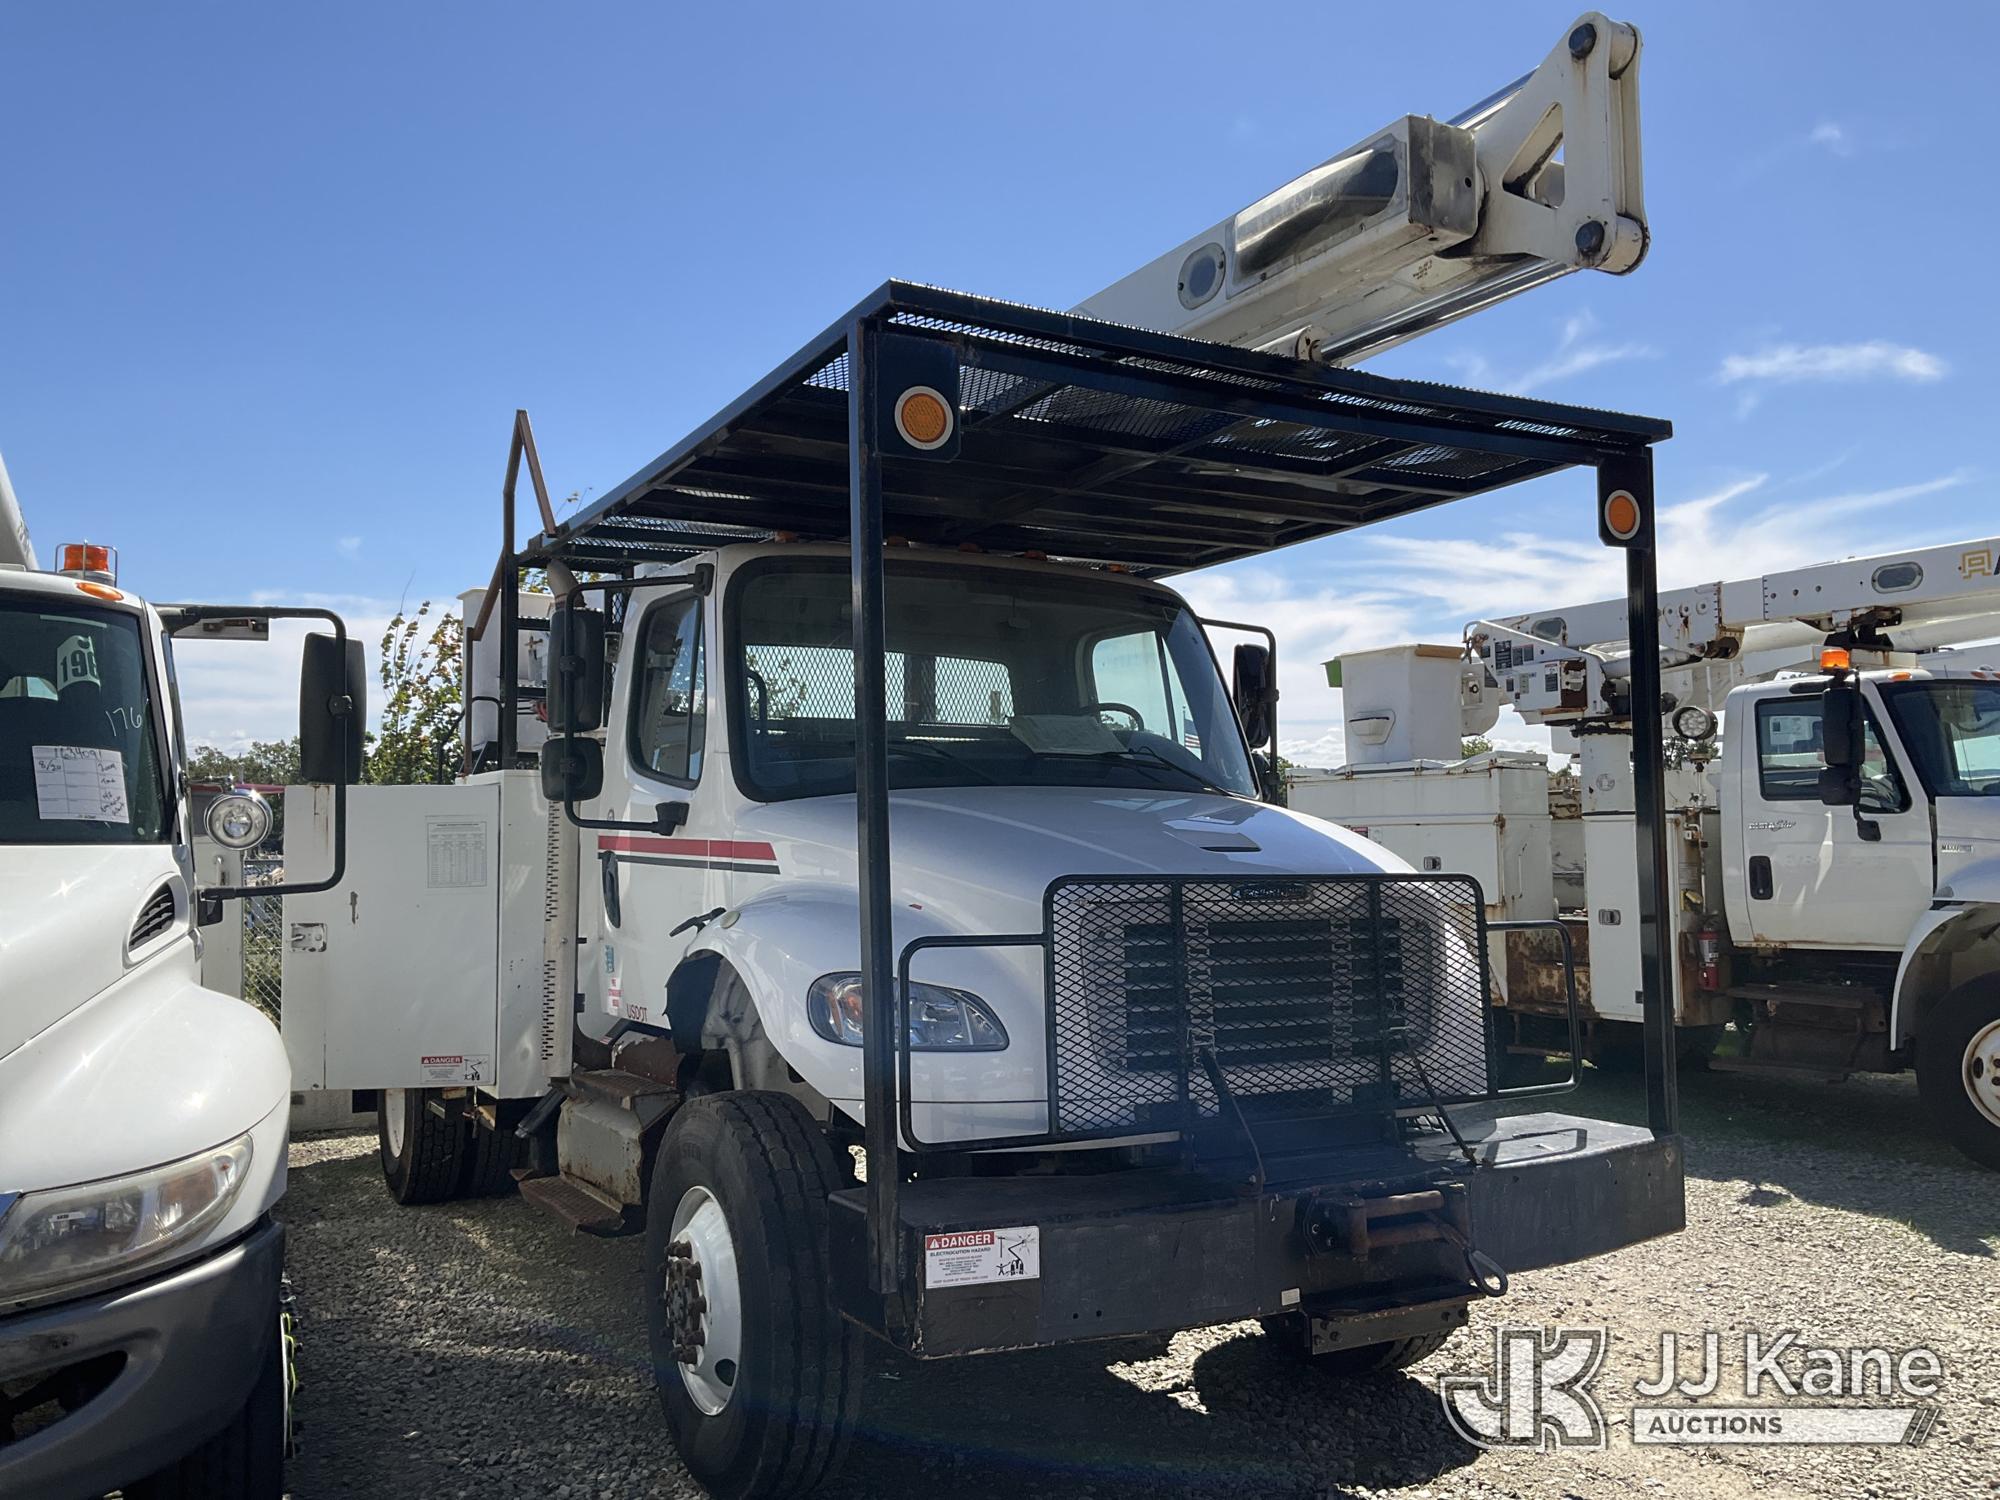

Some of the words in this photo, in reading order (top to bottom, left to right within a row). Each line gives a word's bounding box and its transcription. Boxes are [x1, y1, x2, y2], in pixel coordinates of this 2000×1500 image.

[105, 706, 142, 737] 176
[627, 1003, 648, 1022] USDOT
[941, 1233, 991, 1248] DANGER
[930, 1249, 970, 1257] ELECTROCUTION
